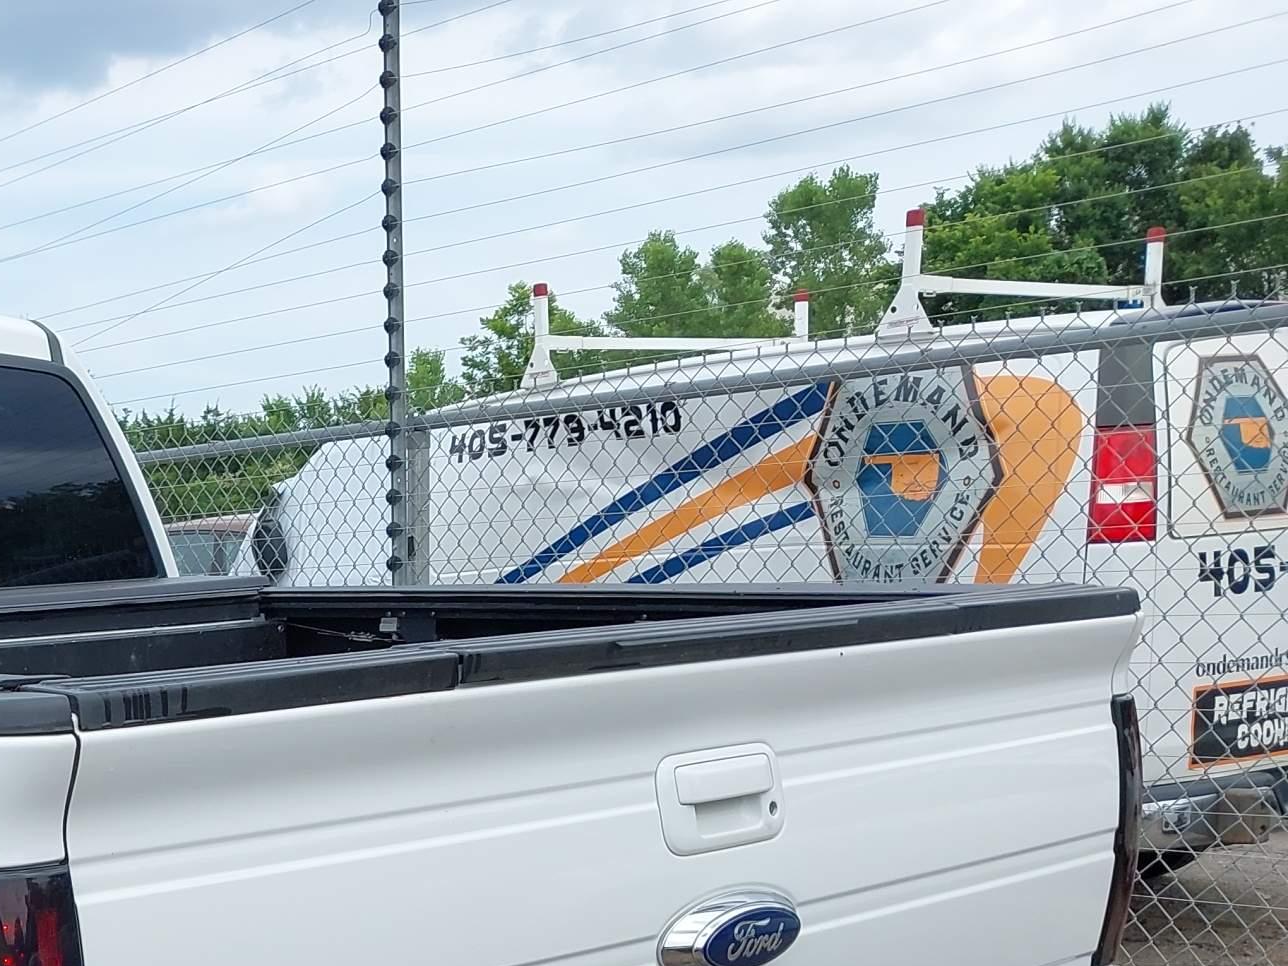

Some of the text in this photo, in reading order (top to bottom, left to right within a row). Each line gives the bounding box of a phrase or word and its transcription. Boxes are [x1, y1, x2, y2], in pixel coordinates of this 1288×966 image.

[823, 374, 979, 467] ONDEMAND
[1200, 366, 1286, 426] ONDEMAND
[449, 400, 682, 463] 405-779-4210
[1206, 448, 1265, 506] RESTAURANT
[830, 492, 970, 583] RESTAURANT SERVICE
[1196, 647, 1288, 677] ondemandr
[1213, 686, 1288, 725] REFRIG
[727, 917, 784, 961] Ford
